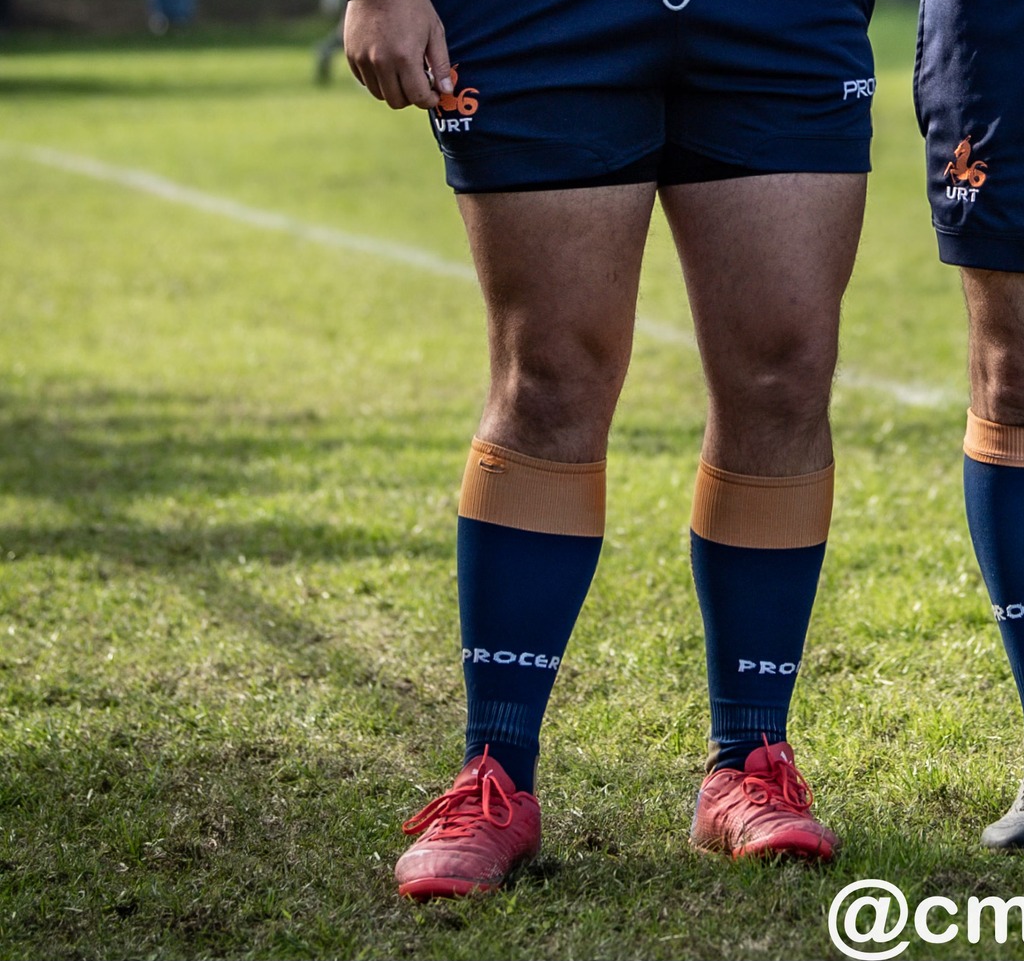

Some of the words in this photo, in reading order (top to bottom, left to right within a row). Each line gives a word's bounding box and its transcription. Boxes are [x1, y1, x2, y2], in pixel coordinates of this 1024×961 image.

[435, 117, 473, 133] URT
[945, 185, 980, 203] URT
[461, 647, 561, 670] PROCER
[737, 659, 802, 675] PRO
